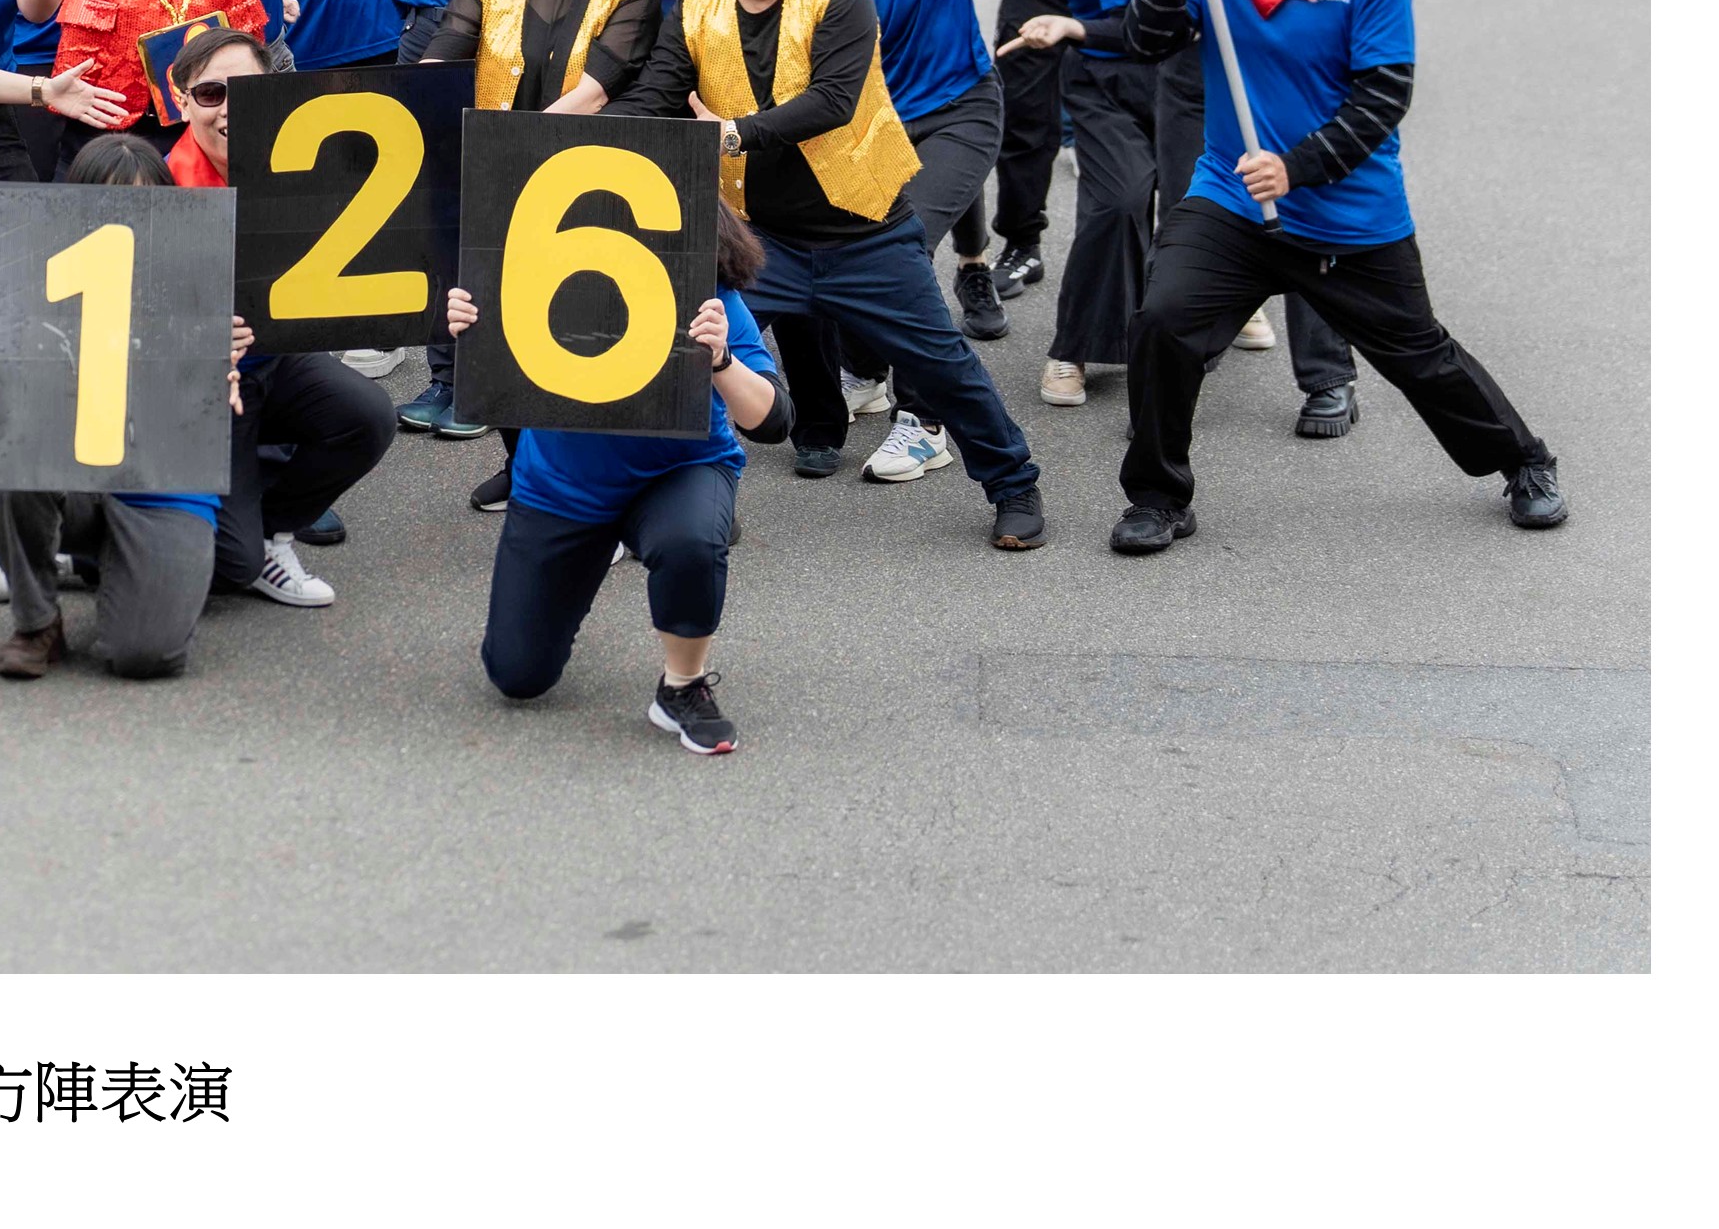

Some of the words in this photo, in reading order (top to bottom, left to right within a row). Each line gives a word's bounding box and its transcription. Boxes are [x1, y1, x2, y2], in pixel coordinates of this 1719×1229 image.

[269, 91, 429, 320] 2
[500, 144, 683, 404] 6
[45, 223, 136, 467] 1
